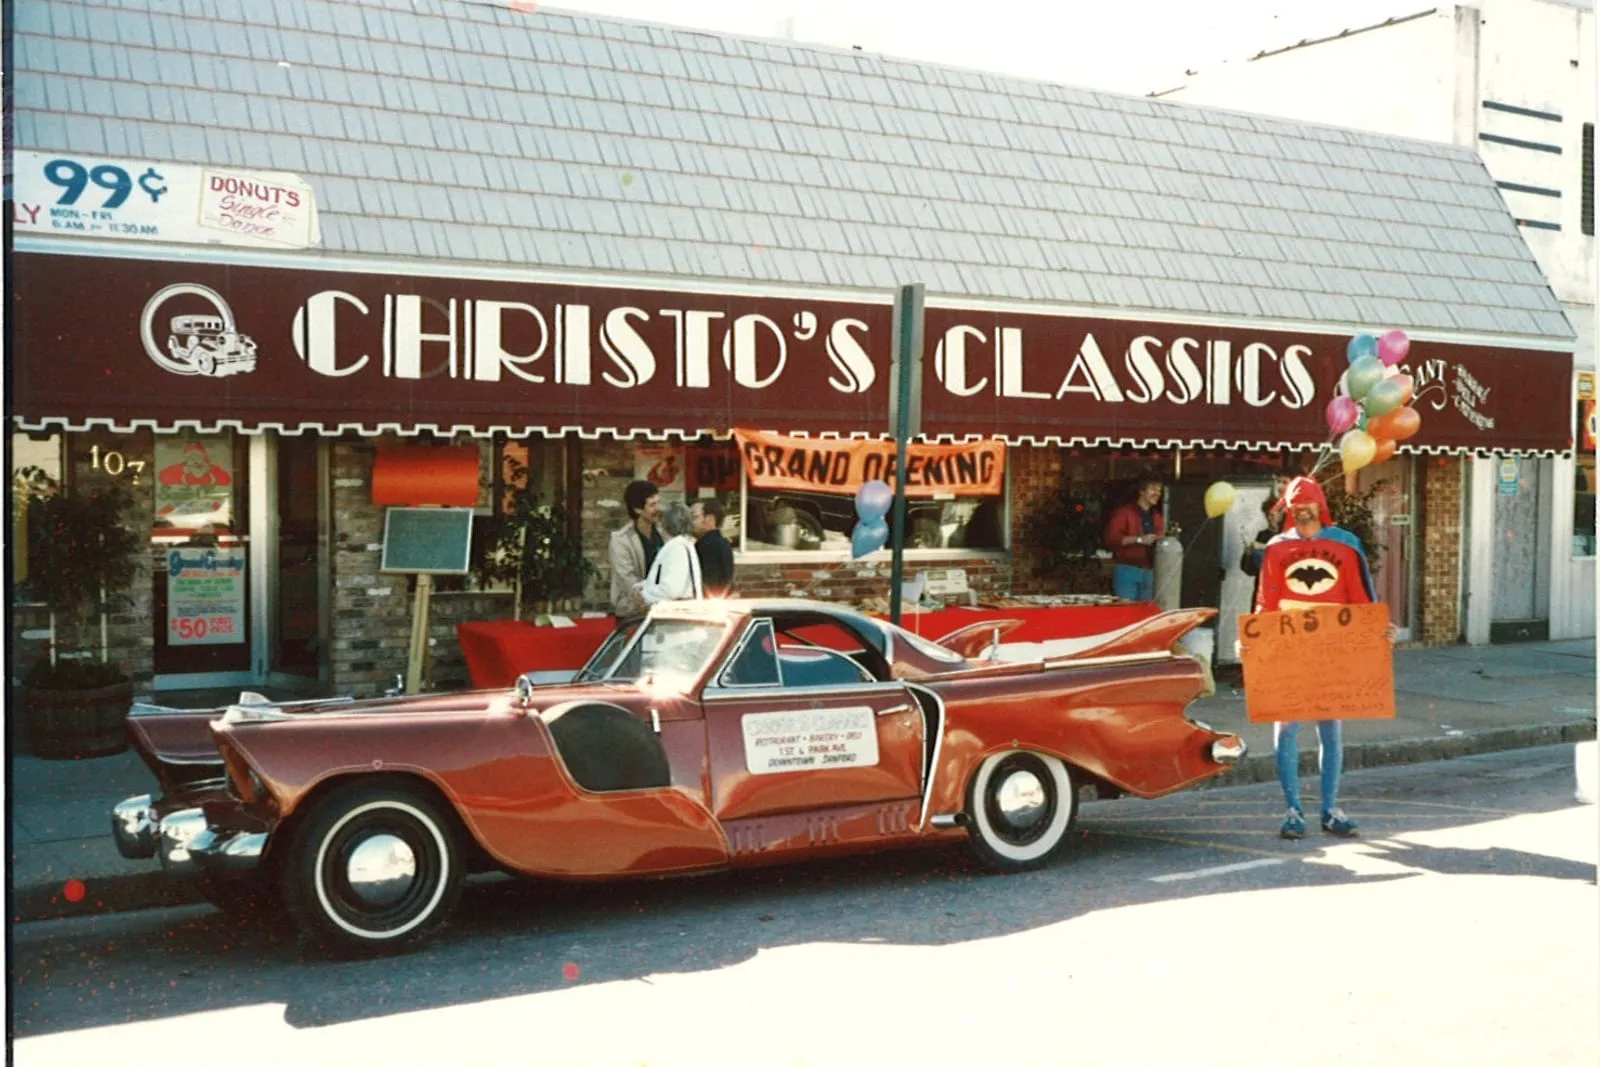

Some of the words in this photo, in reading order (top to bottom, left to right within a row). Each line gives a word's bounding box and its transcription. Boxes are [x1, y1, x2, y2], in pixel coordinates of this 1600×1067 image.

[210, 175, 301, 208] DONUTS
[218, 194, 280, 221] Single
[63, 221, 86, 231] AM
[293, 290, 876, 394] CHRISTO'S
[935, 324, 1315, 408] CLASSICS
[89, 444, 146, 485] 107
[744, 441, 852, 485] GRAND
[863, 450, 995, 487] OPENING
[768, 756, 815, 768] DOWNTOWN
[808, 744, 829, 753] PARK
